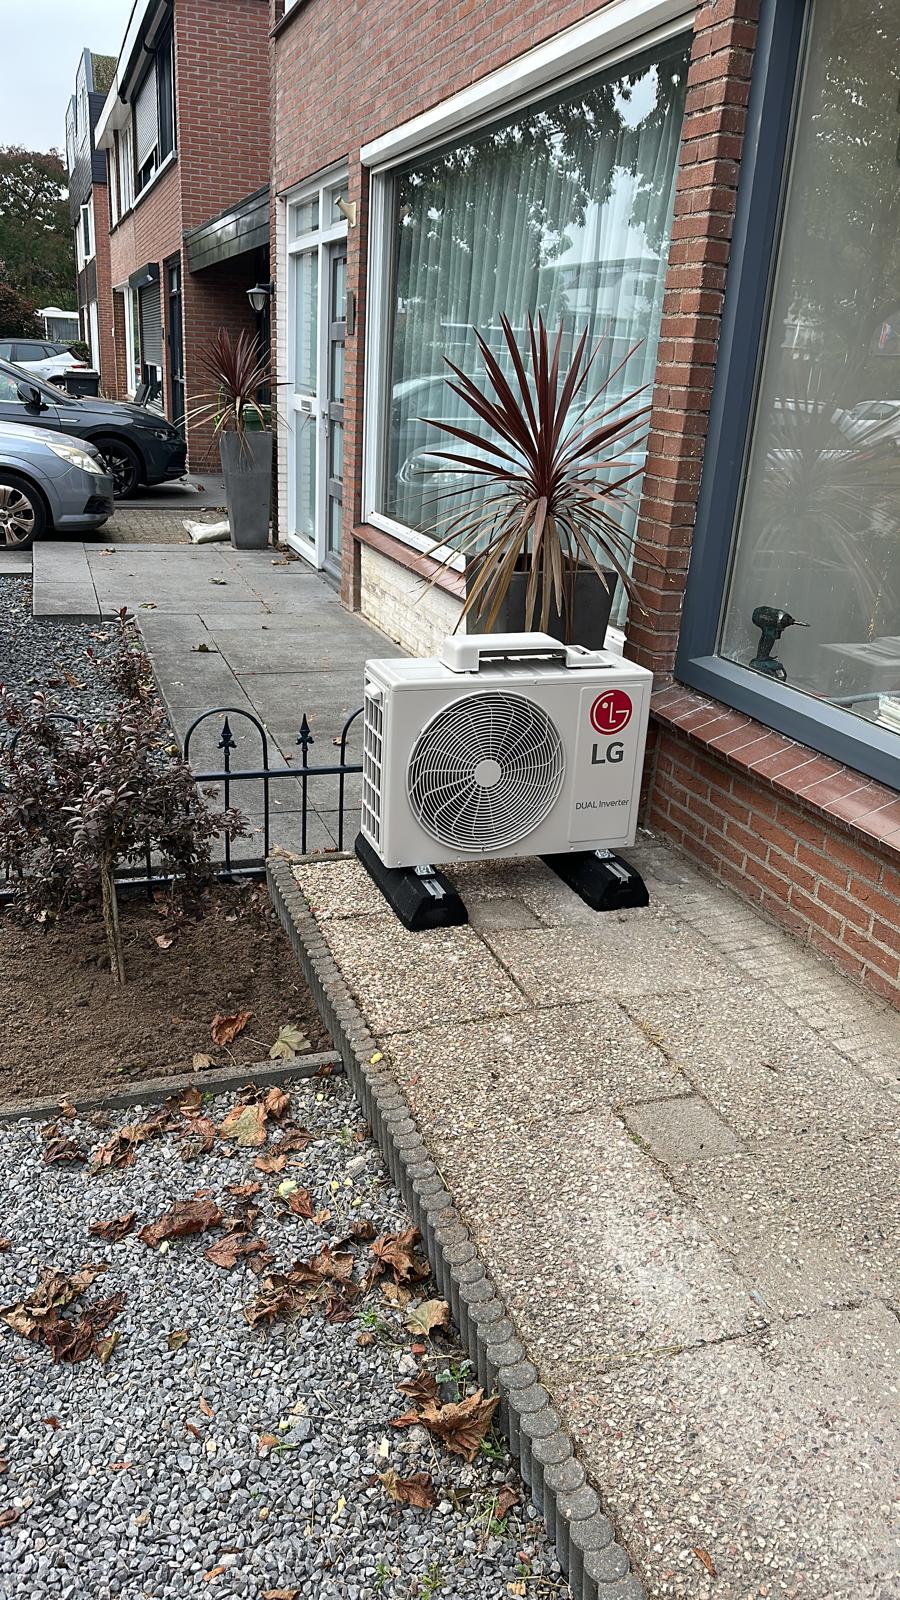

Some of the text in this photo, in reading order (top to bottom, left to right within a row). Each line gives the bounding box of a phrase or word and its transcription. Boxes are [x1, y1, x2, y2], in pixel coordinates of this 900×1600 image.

[593, 692, 630, 732] LG
[591, 742, 624, 765] LG
[575, 799, 629, 810] DUAL Inverter
